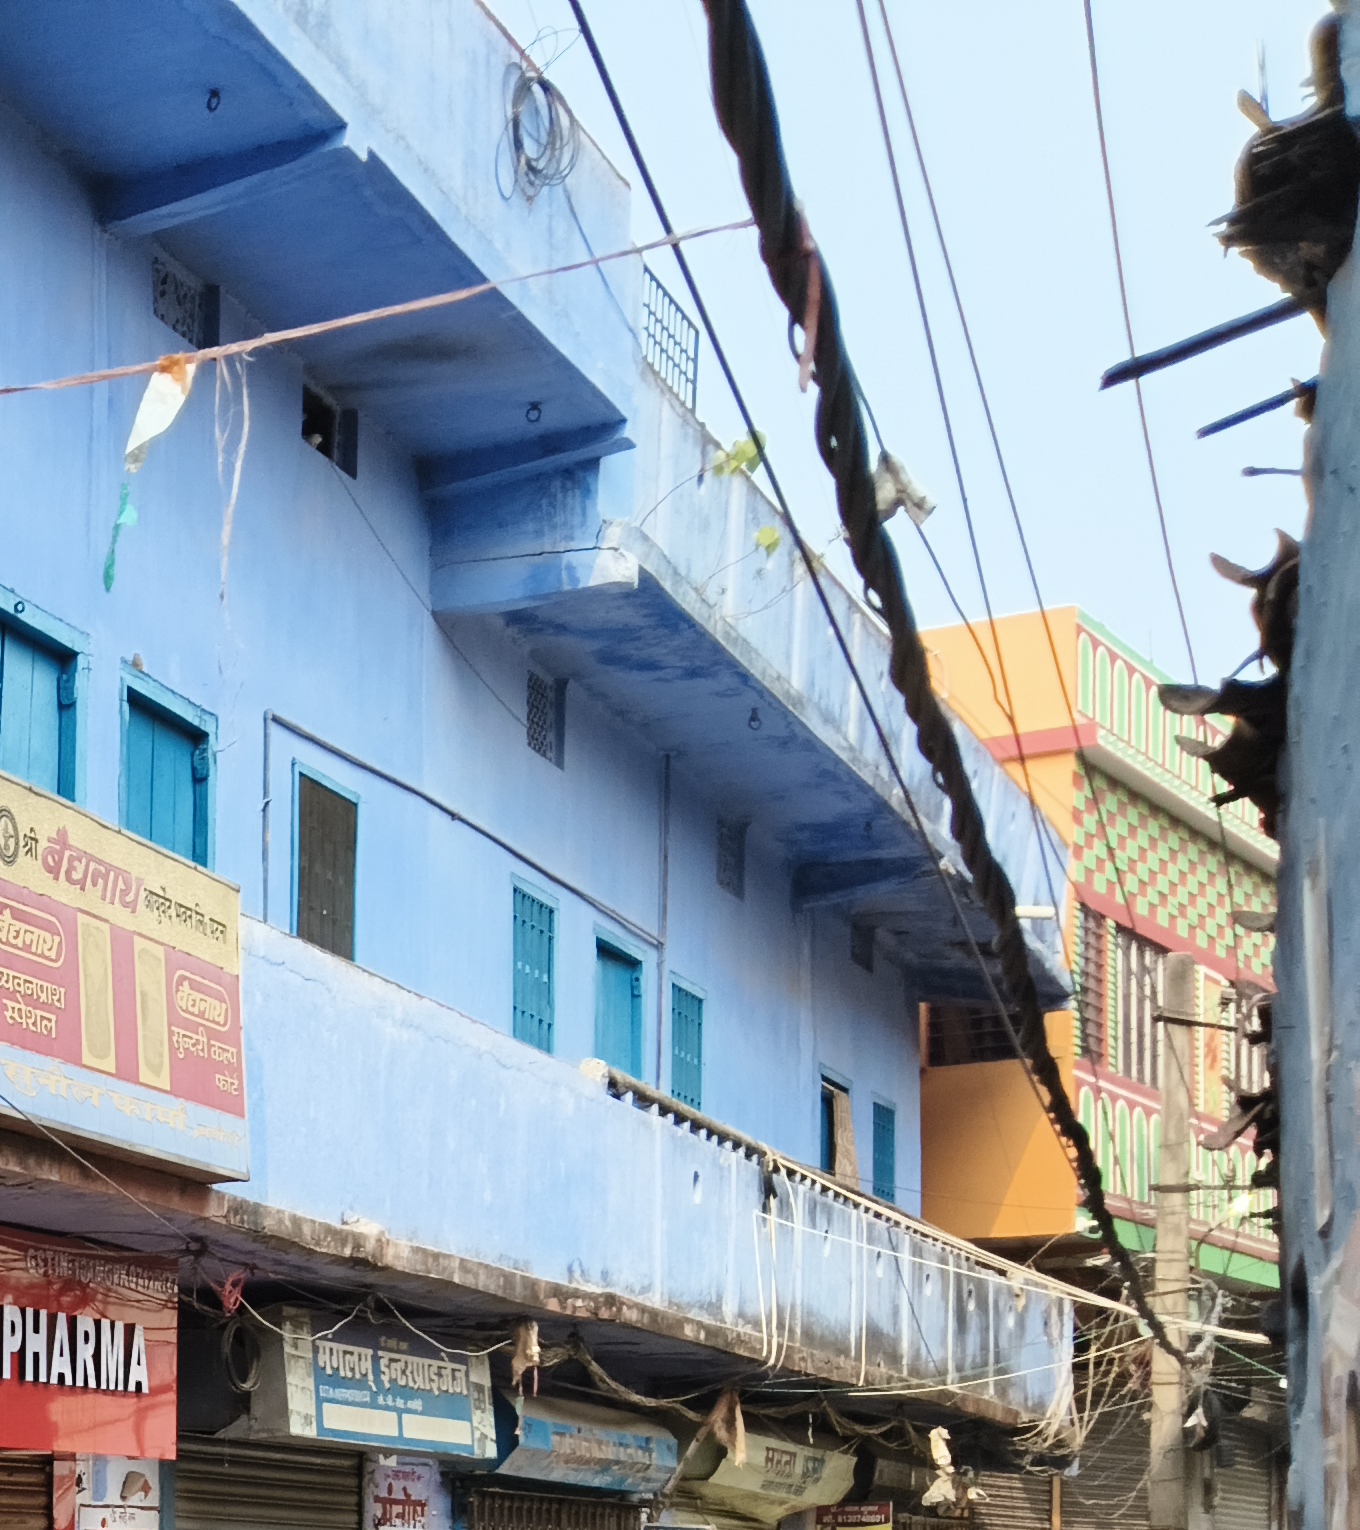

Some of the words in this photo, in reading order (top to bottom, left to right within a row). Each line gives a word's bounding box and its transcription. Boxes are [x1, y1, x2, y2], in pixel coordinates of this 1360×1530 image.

[21, 826, 40, 862] श्री
[41, 825, 146, 915] बैद्यनाथ
[1, 994, 57, 1039] स्पेशल
[176, 979, 228, 1025] बैद्यनाथ
[1, 1303, 150, 1394] PHARMA
